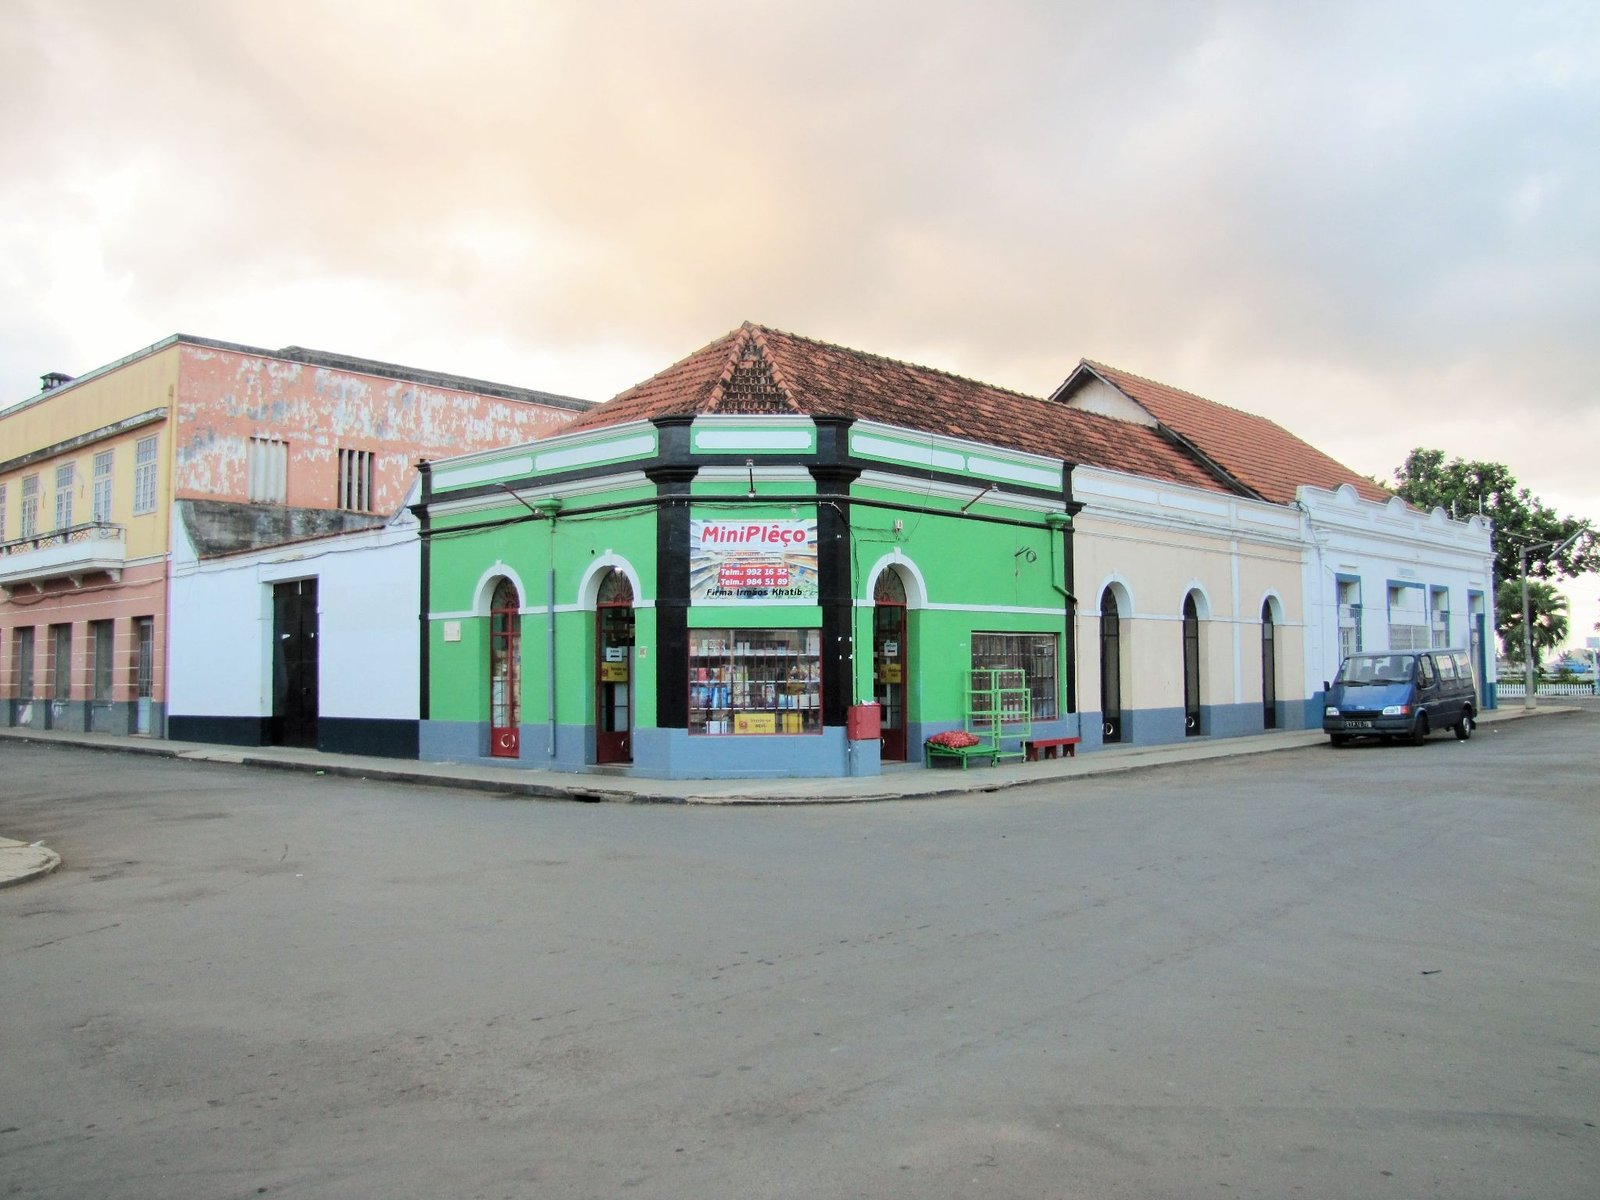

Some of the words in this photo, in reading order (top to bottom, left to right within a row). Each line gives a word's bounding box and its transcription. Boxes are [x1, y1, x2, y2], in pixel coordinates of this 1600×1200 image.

[702, 525, 806, 547] MiniPlêço
[706, 588, 733, 596] Firma
[736, 587, 769, 596] Irmãos
[772, 588, 803, 596] Khatib
